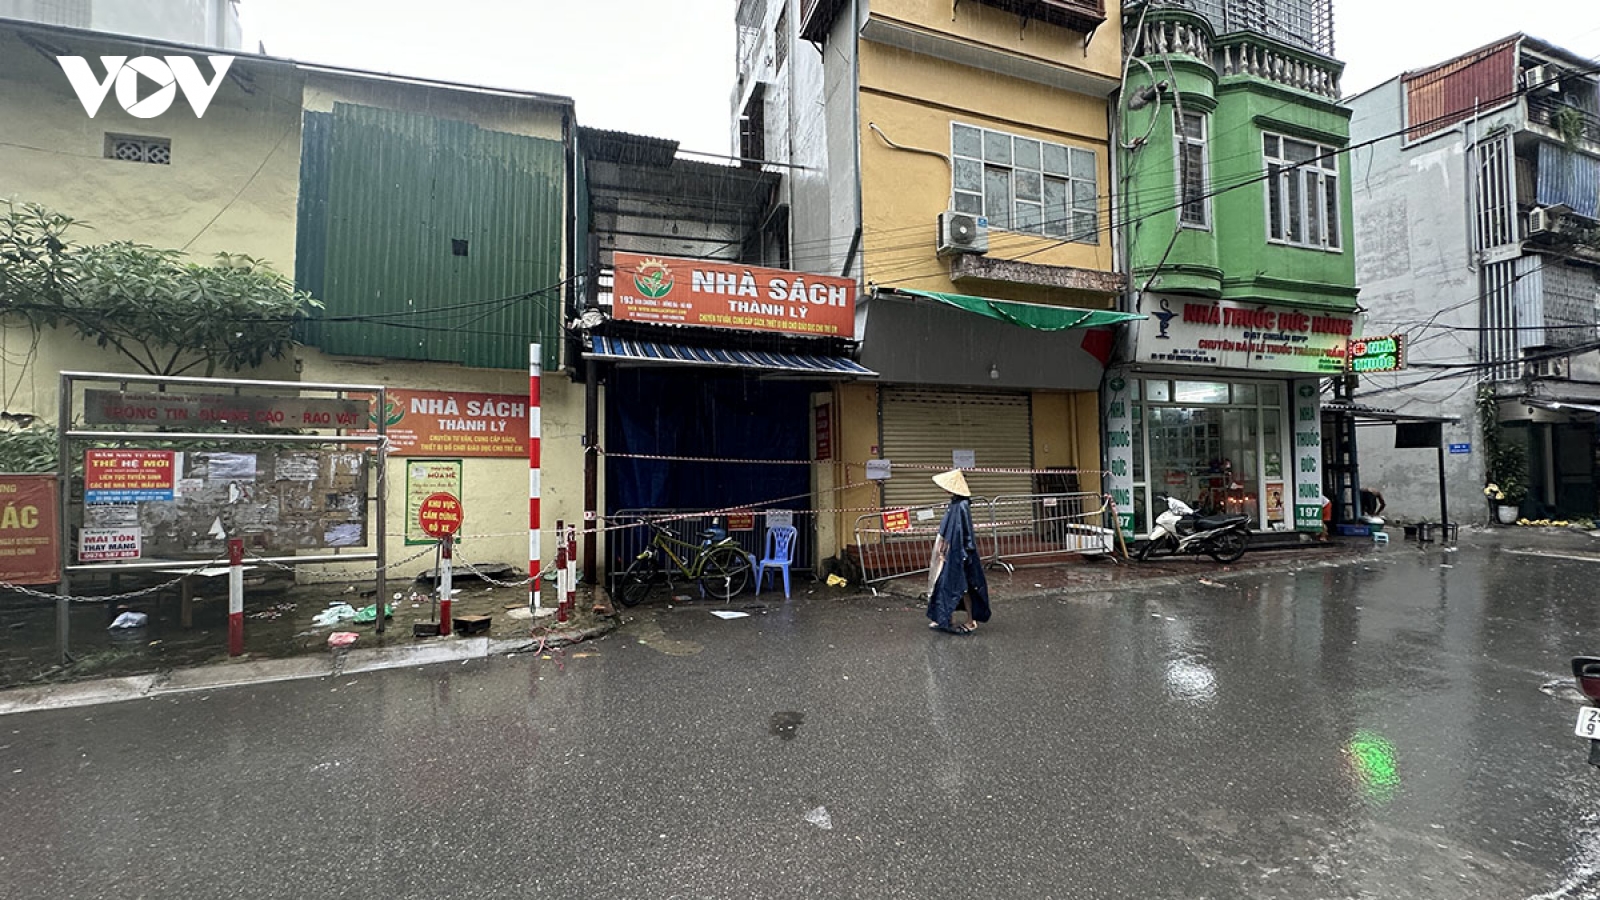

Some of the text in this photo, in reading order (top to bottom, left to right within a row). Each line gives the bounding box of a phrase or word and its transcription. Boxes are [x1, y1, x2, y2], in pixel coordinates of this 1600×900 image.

[692, 270, 847, 307] NHÀ SÁCH
[728, 299, 808, 318] THÀNH LÝ
[1184, 301, 1353, 336] NHÀ THUỐC ĐỨC HÙNG
[1367, 338, 1397, 355] NHÀ
[1353, 353, 1397, 371] THUỐC
[164, 407, 189, 420] TIN
[303, 410, 331, 424] RAO
[411, 396, 525, 418] NHÀ SÁCH
[438, 417, 507, 432] THÀNH LÝ
[1108, 424, 1130, 447] THUỐC
[1296, 427, 1320, 447] THUỐC
[92, 458, 169, 468] THẾ HỆ MỚI
[1300, 454, 1317, 472] ĐỨC
[1299, 480, 1319, 498] HÙNG
[1300, 507, 1319, 517] 197
[84, 544, 105, 552] THAY
